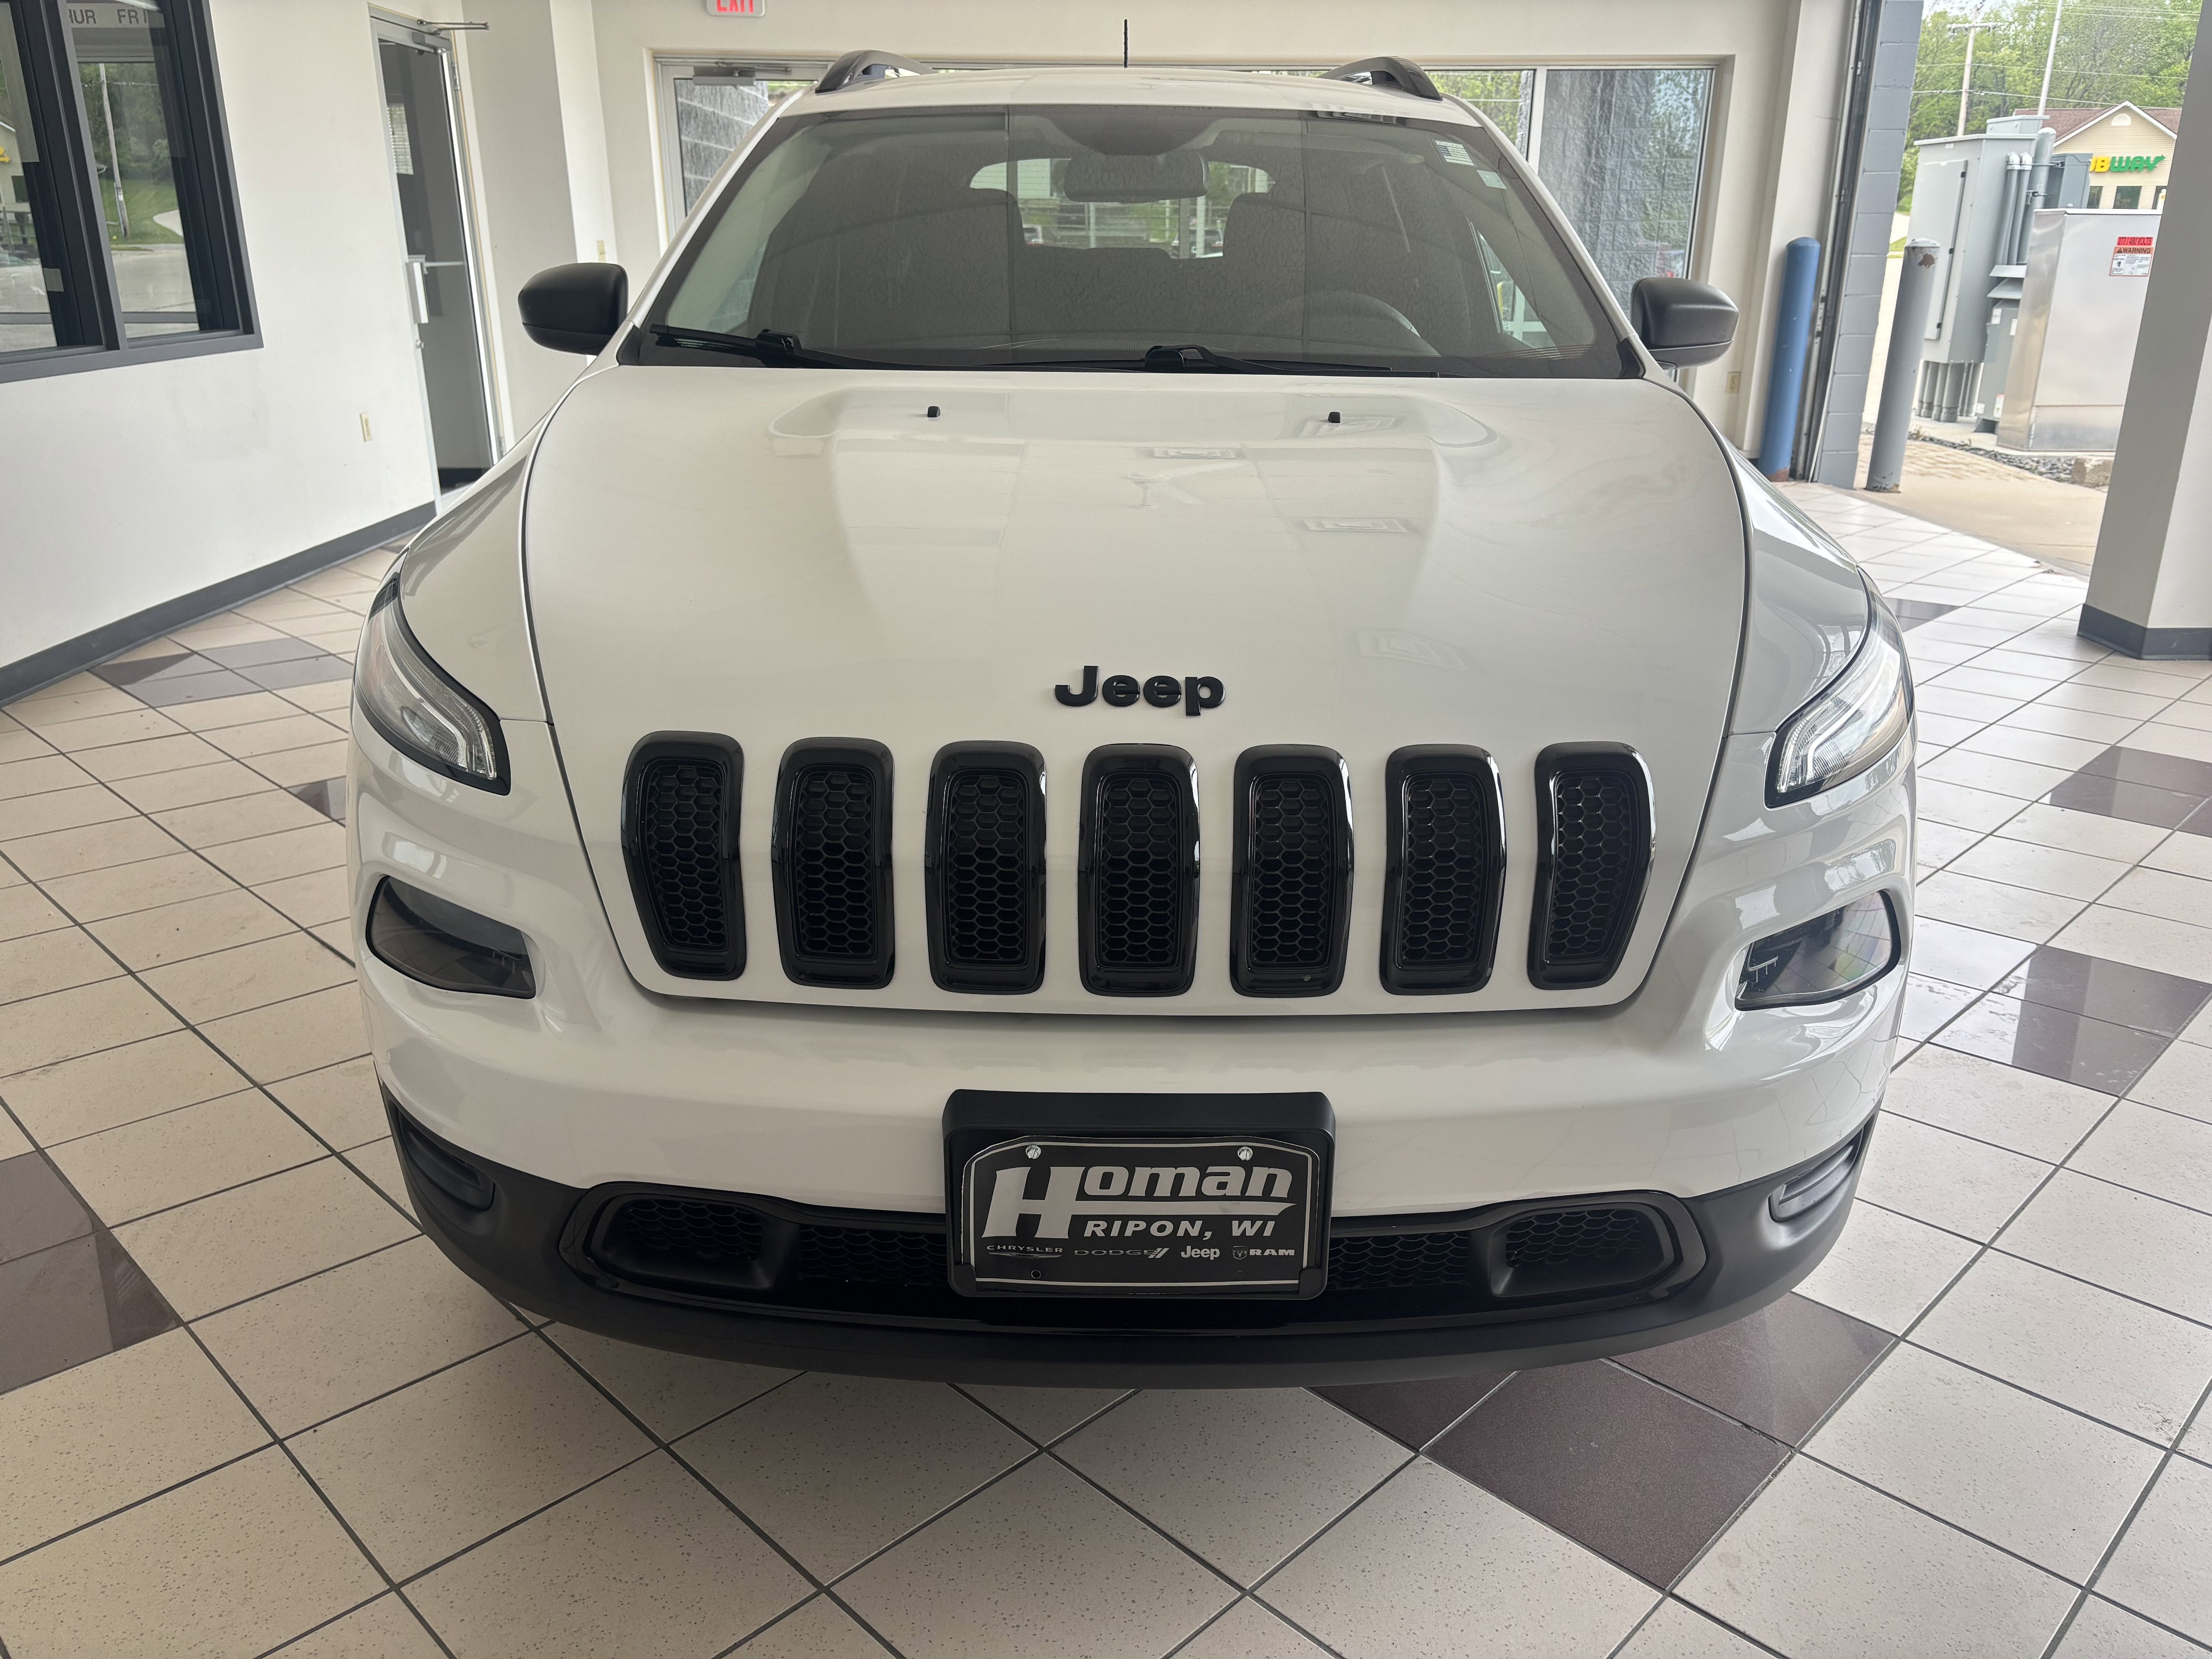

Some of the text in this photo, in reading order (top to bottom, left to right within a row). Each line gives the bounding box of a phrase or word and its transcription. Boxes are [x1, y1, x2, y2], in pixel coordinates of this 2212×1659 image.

[1054, 665, 1226, 716] Jeep
[981, 1165, 1293, 1239] Homan
[1084, 1220, 1275, 1240] RIPON, WI
[986, 1245, 1063, 1253] CHRYSLER
[1180, 1245, 1220, 1261] Jeep
